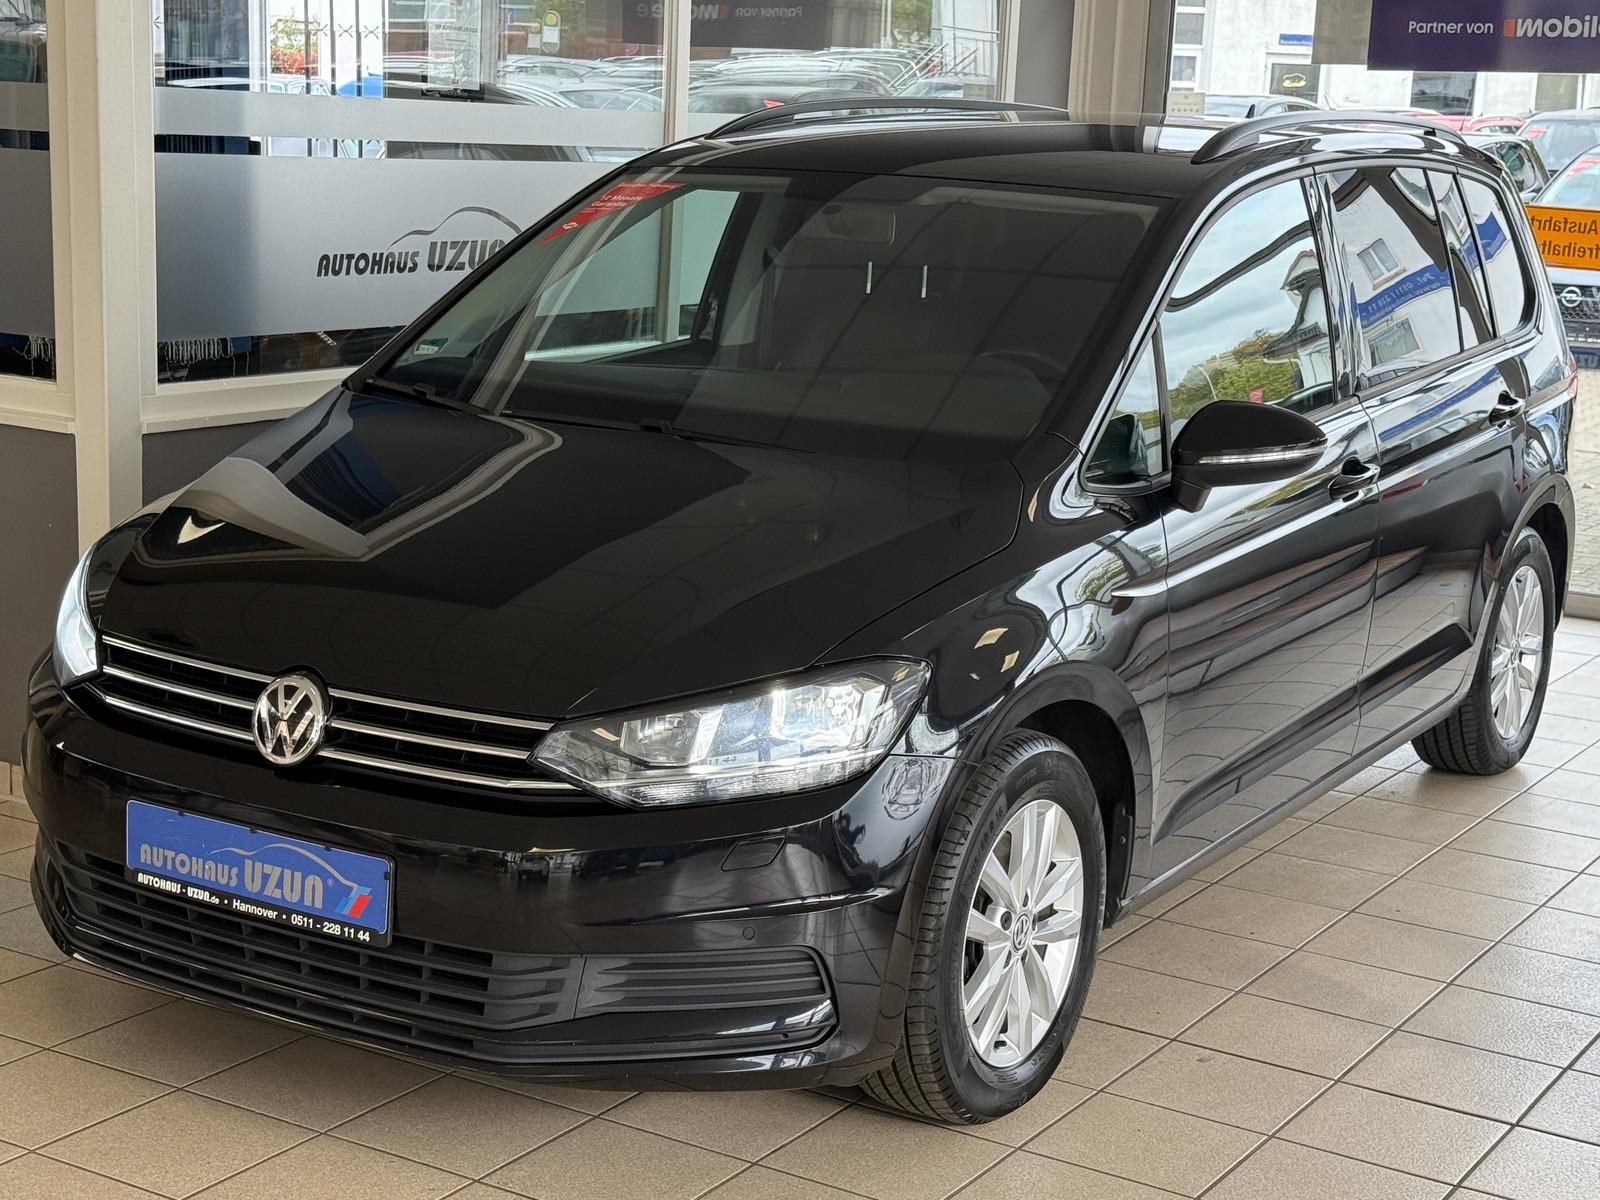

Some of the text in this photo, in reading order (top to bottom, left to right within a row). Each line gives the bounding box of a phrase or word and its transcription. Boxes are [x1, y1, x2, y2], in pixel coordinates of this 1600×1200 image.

[1408, 15, 1600, 38] Partner von mobil
[316, 251, 420, 277] AUTOHAUS
[140, 843, 325, 910] AUTOHAUS UZUN
[137, 872, 182, 894] AUTOHAUS
[232, 898, 279, 920] Hannover
[291, 913, 314, 929] 0511
[323, 921, 341, 936] 228
[343, 926, 355, 939] 11
[357, 929, 370, 942] 44
